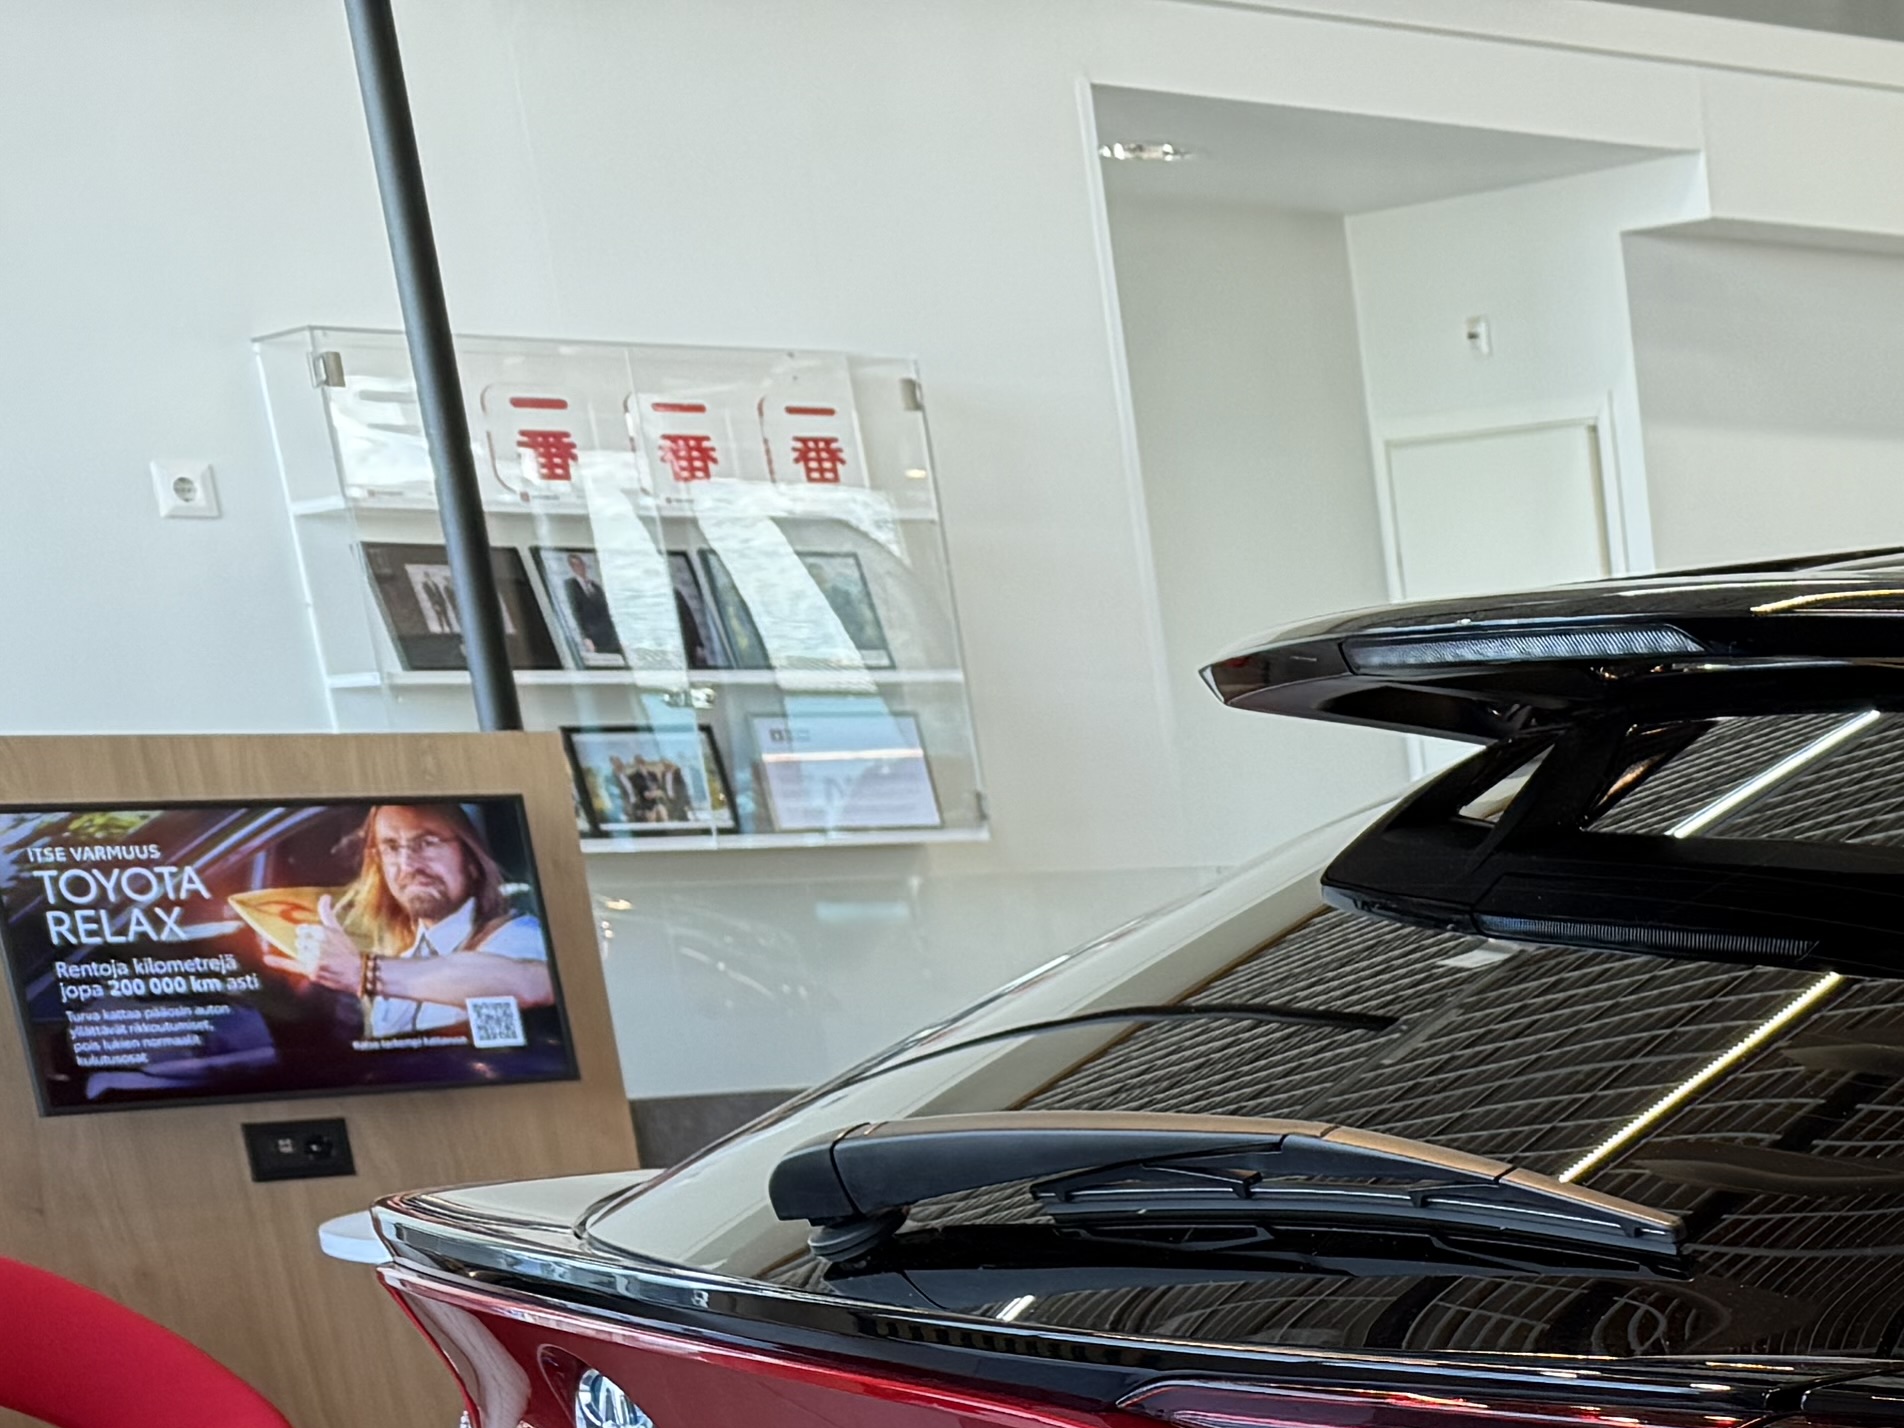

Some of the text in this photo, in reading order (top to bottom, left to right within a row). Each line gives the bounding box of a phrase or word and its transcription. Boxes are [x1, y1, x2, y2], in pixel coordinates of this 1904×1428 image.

[27, 844, 161, 863] ITSE VARMUUS
[32, 865, 212, 904] TOYOTA
[46, 906, 188, 945] RELAX
[55, 954, 238, 979] Rentoja kilometrejä
[59, 973, 260, 1003] jopa 200 000 km asti
